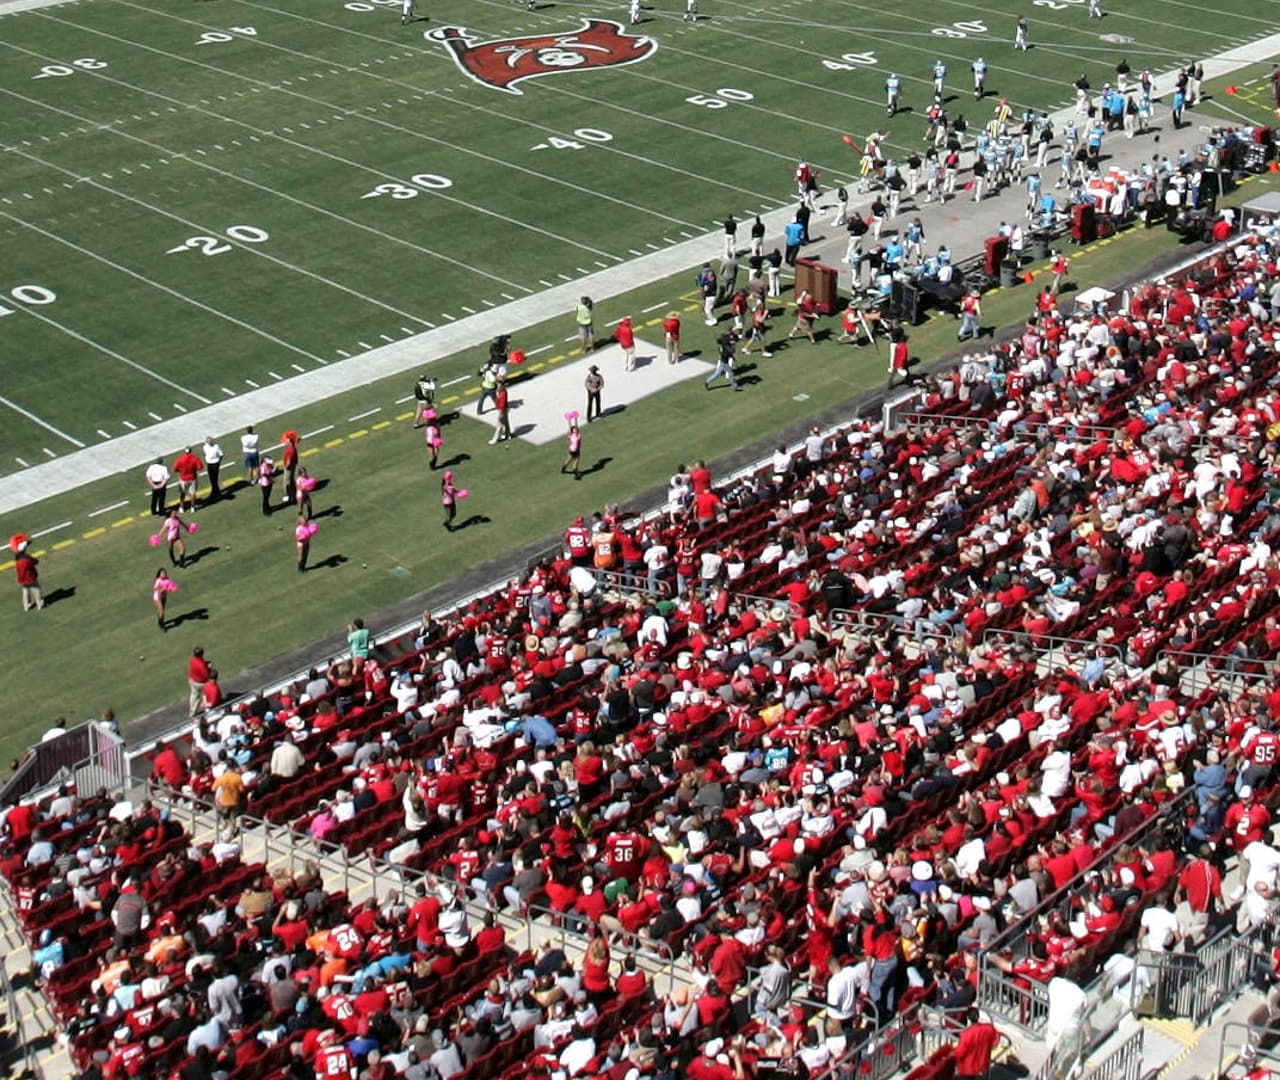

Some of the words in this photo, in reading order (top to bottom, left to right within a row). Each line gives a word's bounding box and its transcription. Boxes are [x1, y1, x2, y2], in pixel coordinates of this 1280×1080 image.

[209, 25, 260, 45] 40
[931, 20, 988, 39] 30
[45, 56, 108, 79] 30
[822, 50, 878, 72] 40
[687, 87, 755, 110] 50
[547, 127, 614, 152] 40
[375, 172, 454, 201] 30
[186, 224, 269, 258] 20
[1254, 745, 1275, 763] 95
[1238, 817, 1250, 836] 2
[614, 847, 634, 863] 36
[461, 861, 471, 879] 2
[336, 928, 360, 952] 24
[326, 1053, 348, 1076] 24
